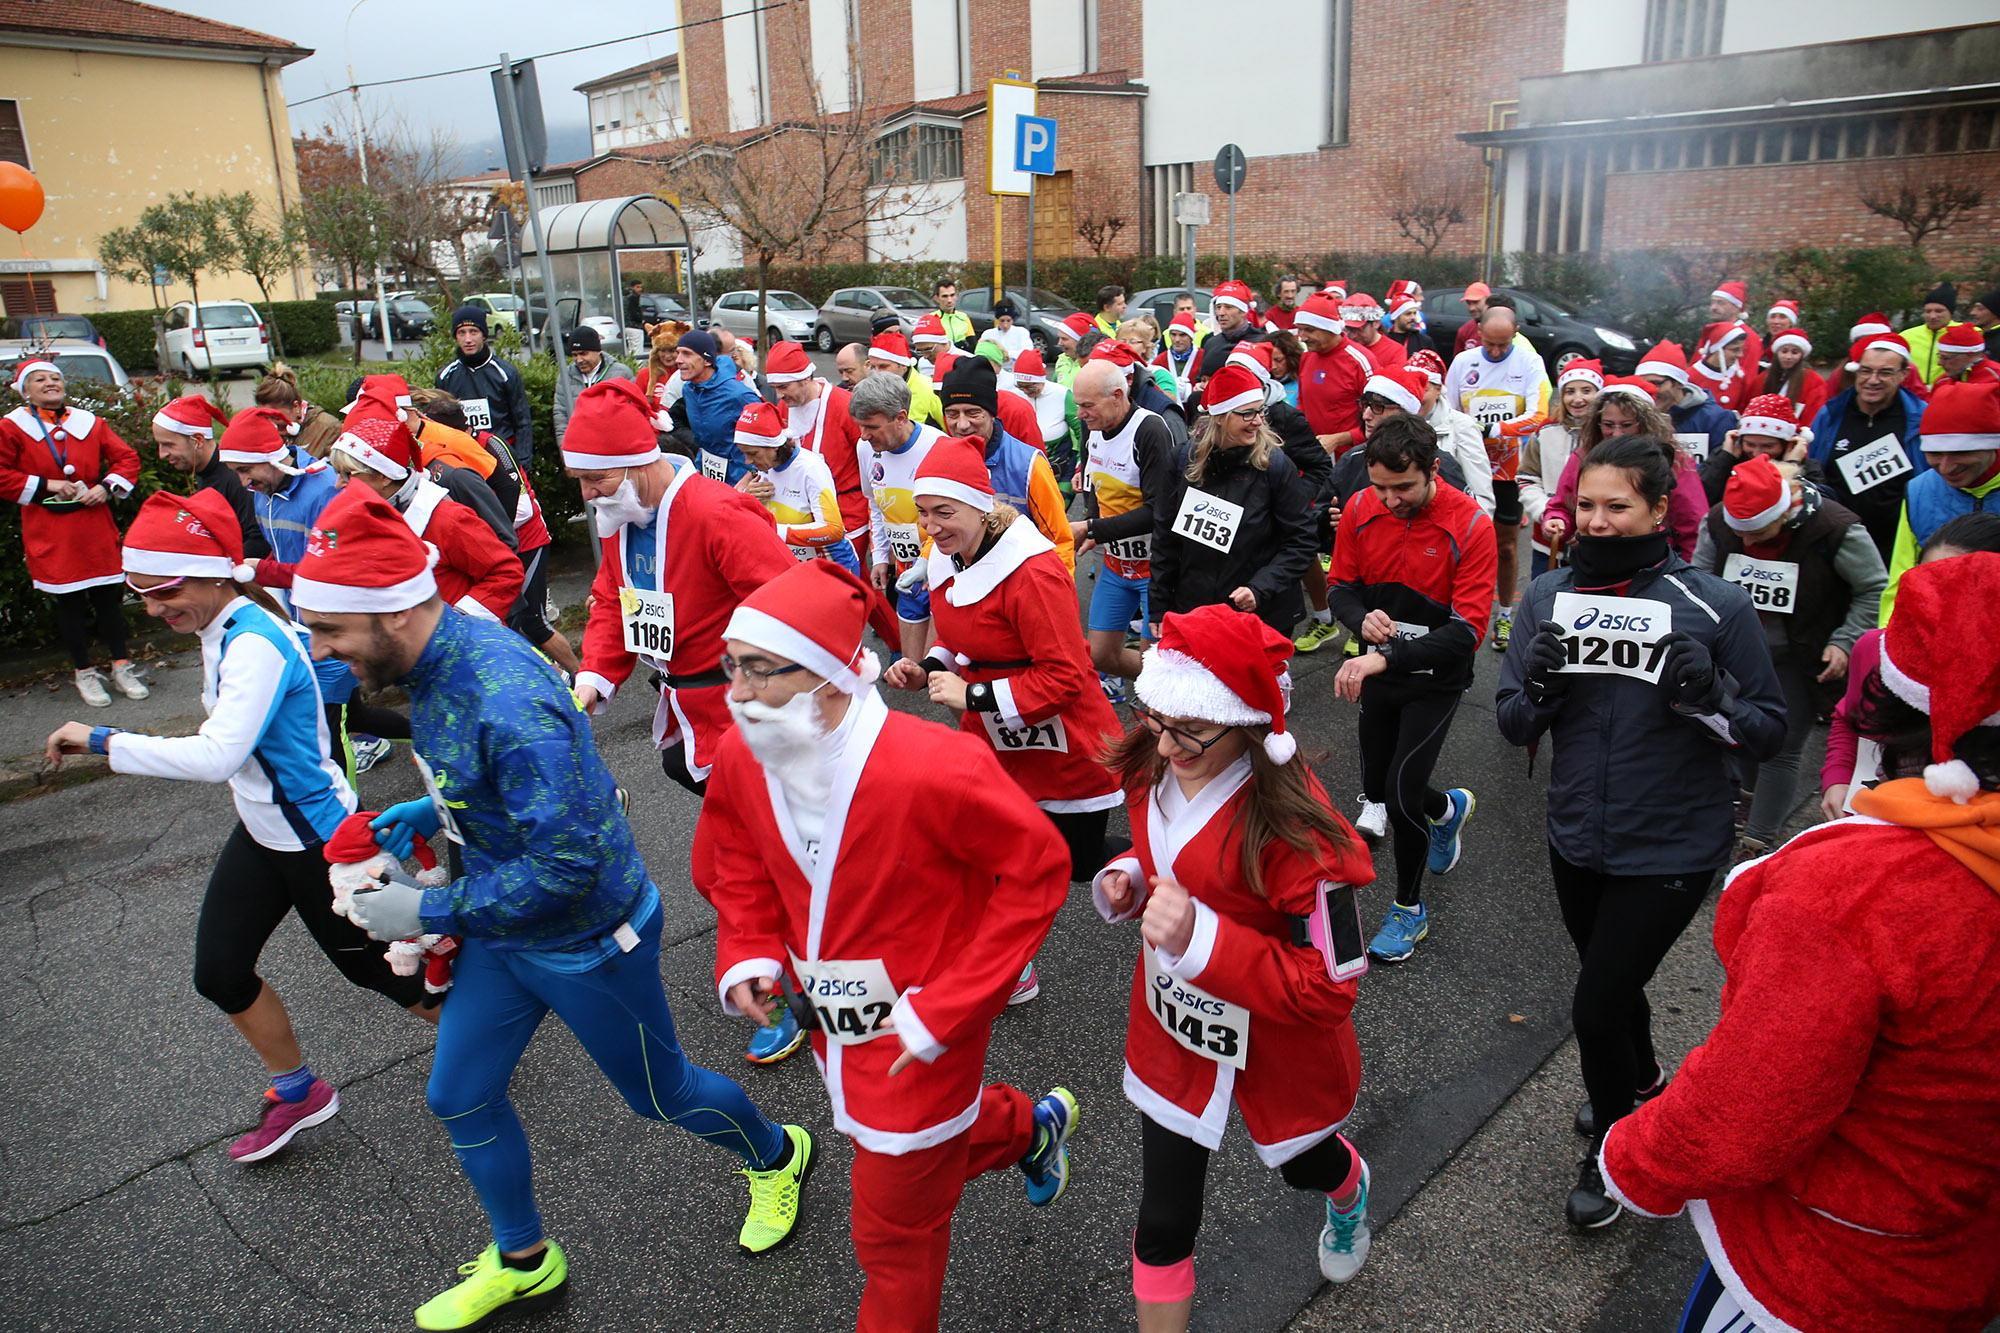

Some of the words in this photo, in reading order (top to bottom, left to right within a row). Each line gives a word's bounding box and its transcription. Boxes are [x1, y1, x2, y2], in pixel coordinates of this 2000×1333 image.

[1023, 122, 1049, 166] P
[1865, 445, 1890, 462] asics
[1853, 454, 1905, 486] 1161
[1206, 506, 1231, 522] asics
[891, 529, 911, 540] asics
[1183, 513, 1232, 547] 1153
[791, 547, 807, 556] sics
[1108, 541, 1148, 558] 818
[1753, 569, 1785, 582] asics
[645, 603, 665, 619] asics
[1598, 614, 1652, 633] asics
[629, 620, 672, 654] 1186
[1561, 635, 1665, 673] 1207
[998, 724, 1059, 748] 821
[818, 980, 868, 997] asics
[1172, 986, 1226, 1017] asics
[1152, 983, 1239, 1057] 1143
